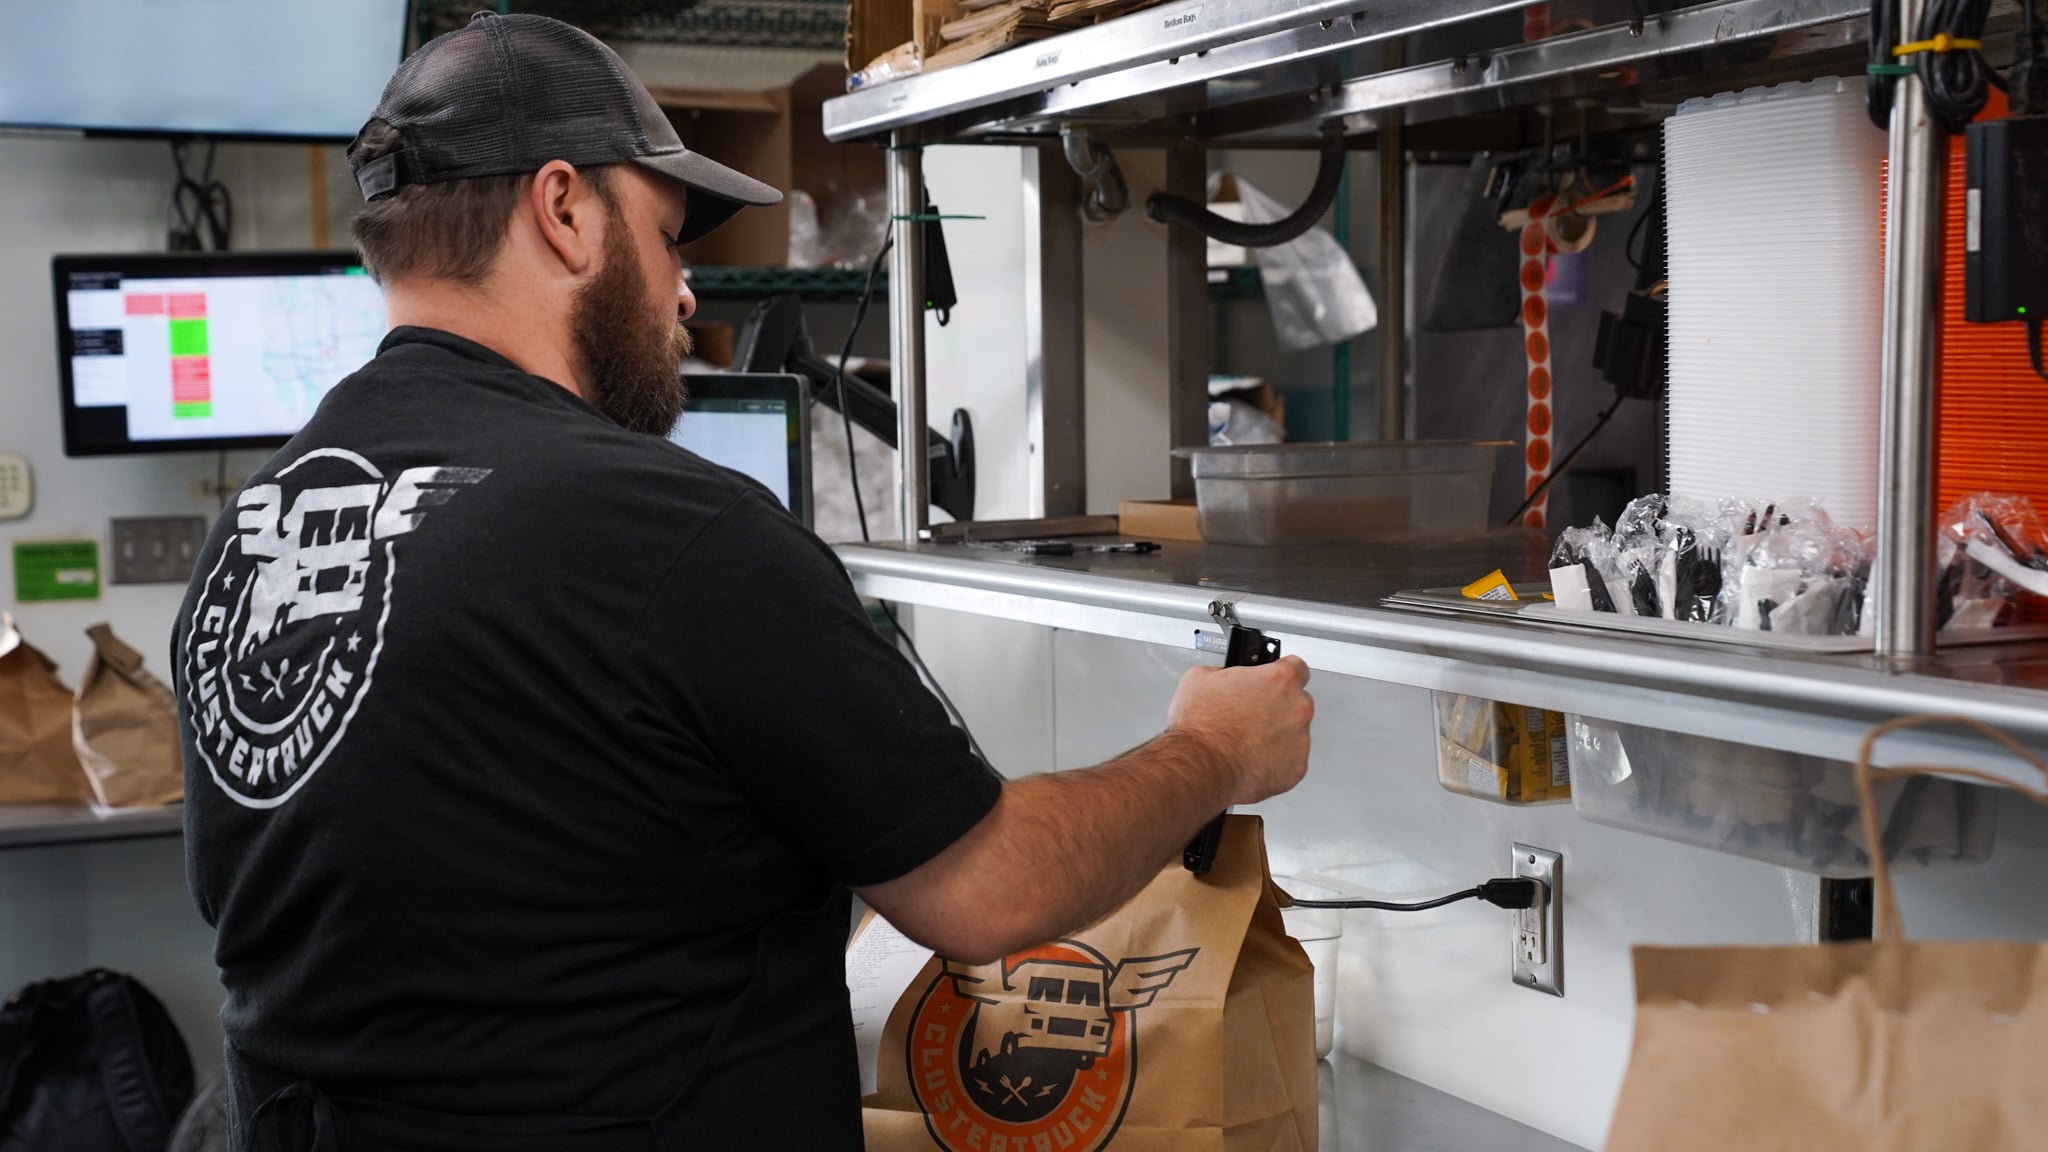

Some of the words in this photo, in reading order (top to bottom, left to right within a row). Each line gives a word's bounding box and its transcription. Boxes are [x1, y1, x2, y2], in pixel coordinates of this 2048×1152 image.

[1183, 13, 1197, 24] Bags
[197, 605, 355, 786] CLUSTERTRUCK
[922, 1023, 1107, 1152] CLUSTERTRUCK
